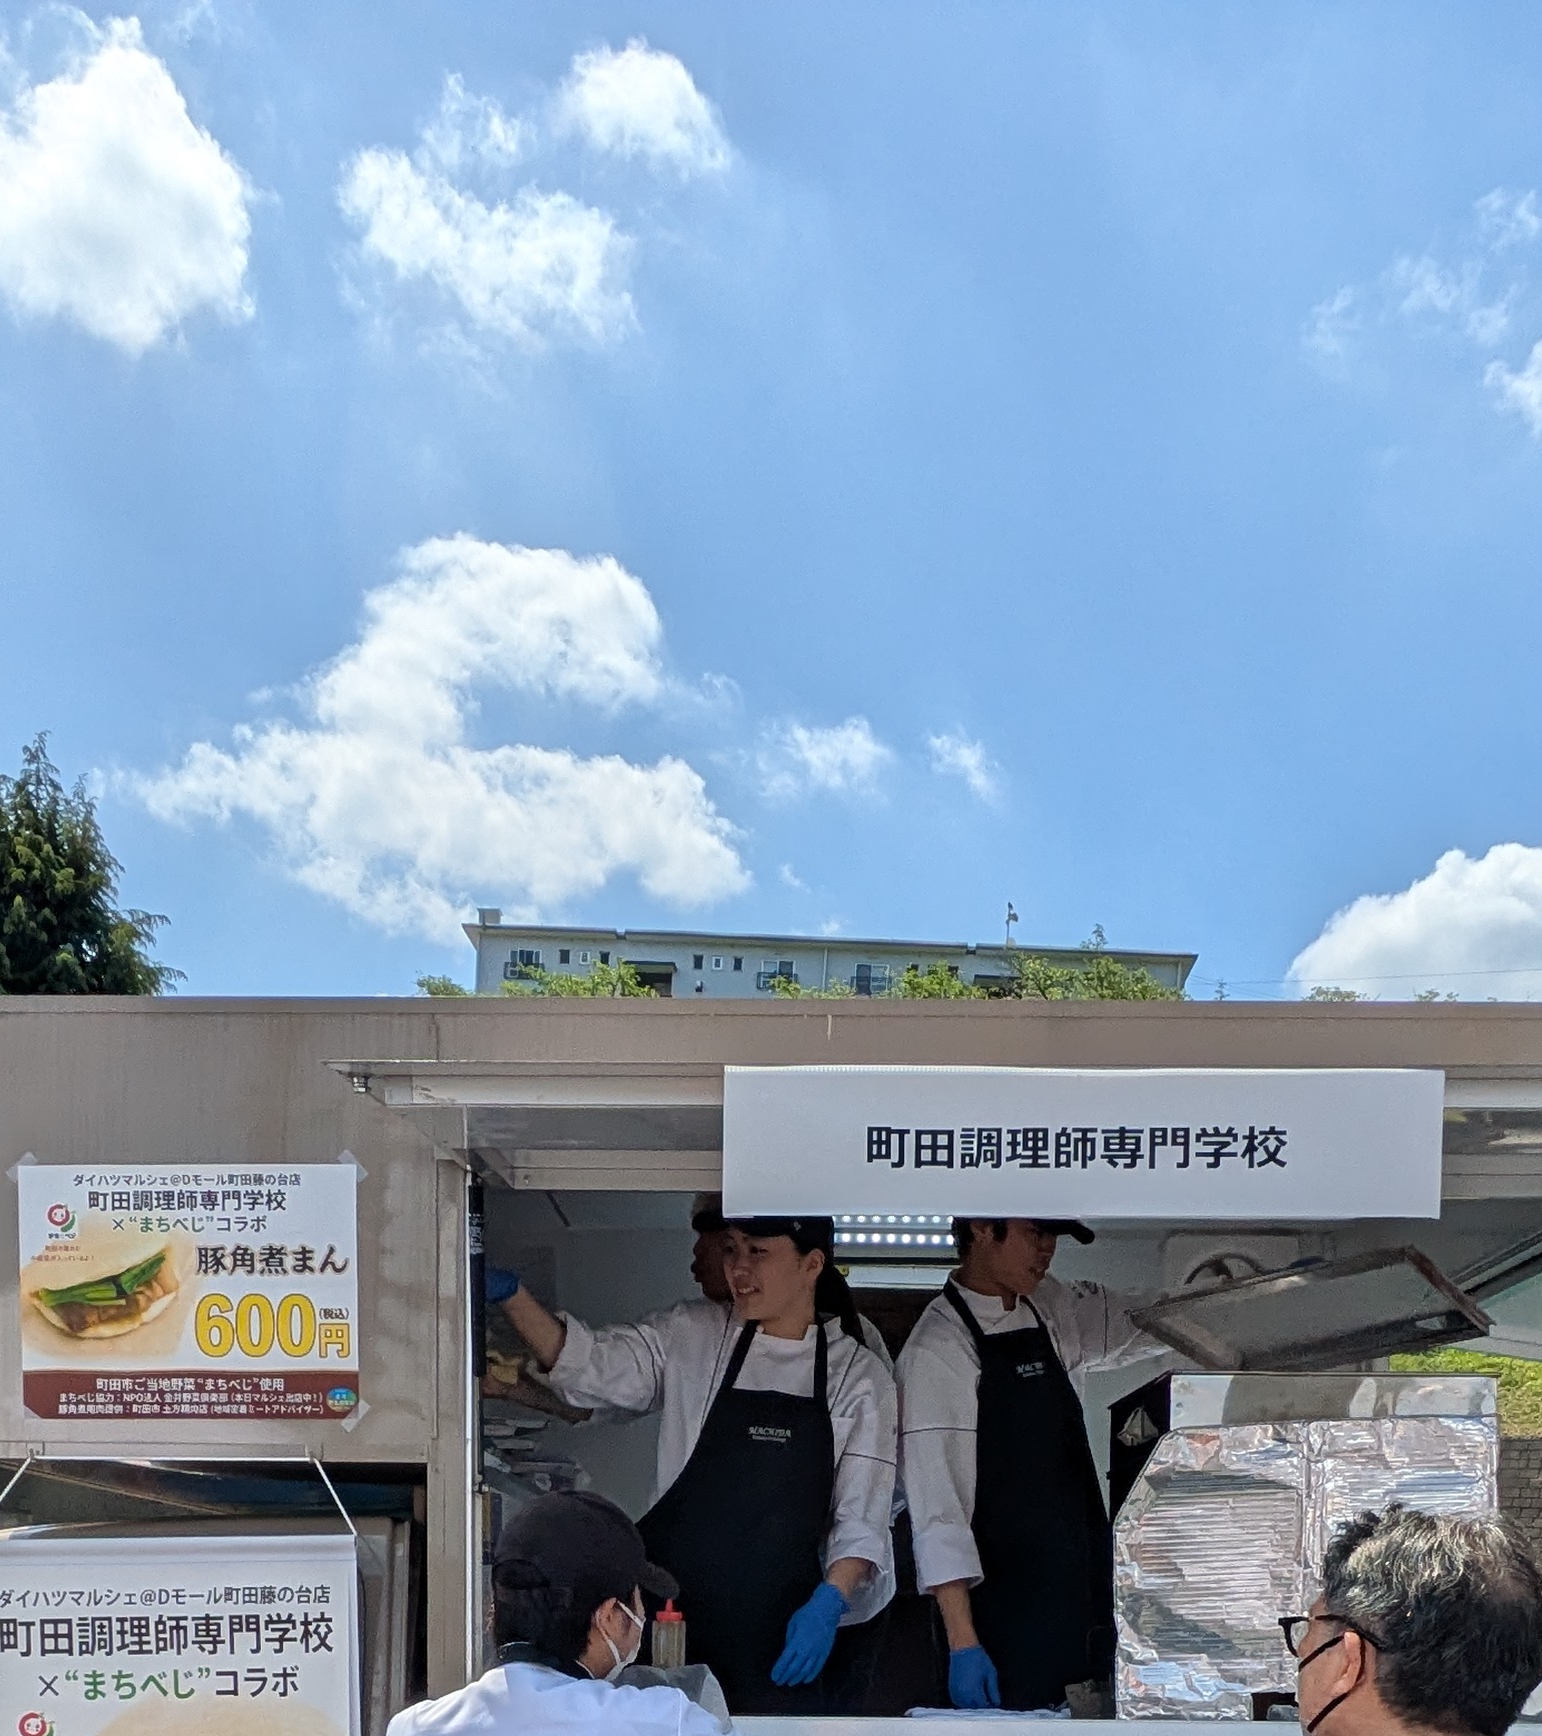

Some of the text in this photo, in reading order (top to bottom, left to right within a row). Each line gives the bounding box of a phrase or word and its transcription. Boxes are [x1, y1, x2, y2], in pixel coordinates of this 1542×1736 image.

[866, 1126, 1288, 1169] 町田調理師専門学校
[88, 1190, 287, 1212] 町田調理師専門学校
[197, 1245, 347, 1275] 豚角煮まん
